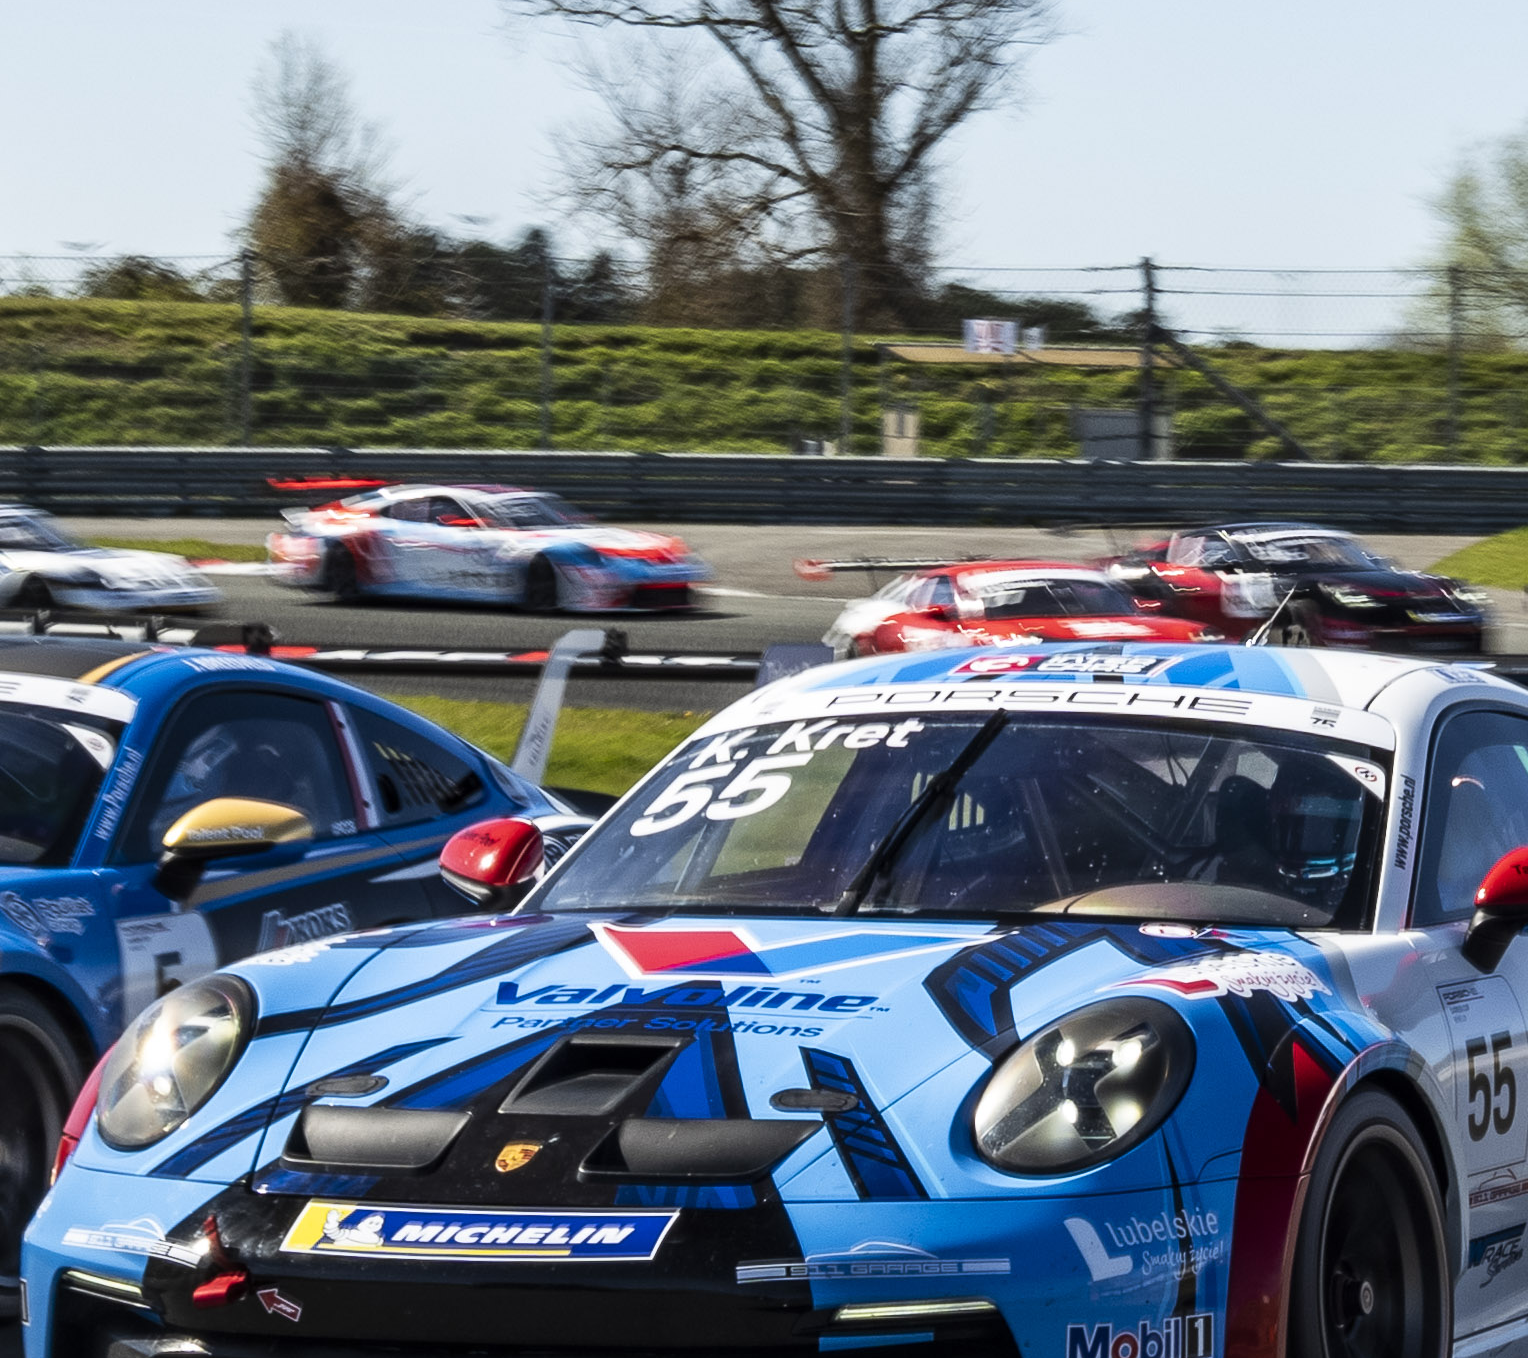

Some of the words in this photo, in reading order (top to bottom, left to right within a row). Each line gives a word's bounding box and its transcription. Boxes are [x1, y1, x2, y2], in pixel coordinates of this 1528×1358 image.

[826, 690, 1254, 717] PORSCHE
[688, 728, 758, 769] K.
[766, 717, 926, 755] Kret
[629, 751, 815, 837] 55
[1393, 773, 1418, 871] www.porsche.nl
[496, 980, 880, 1013] Valvoline
[492, 1016, 638, 1030] Partner
[644, 1016, 825, 1039] Solutions
[1465, 1030, 1517, 1142] 55
[390, 1219, 635, 1245] MICHELIN
[790, 1265, 845, 1277] 911
[849, 1262, 959, 1275] GARAGE
